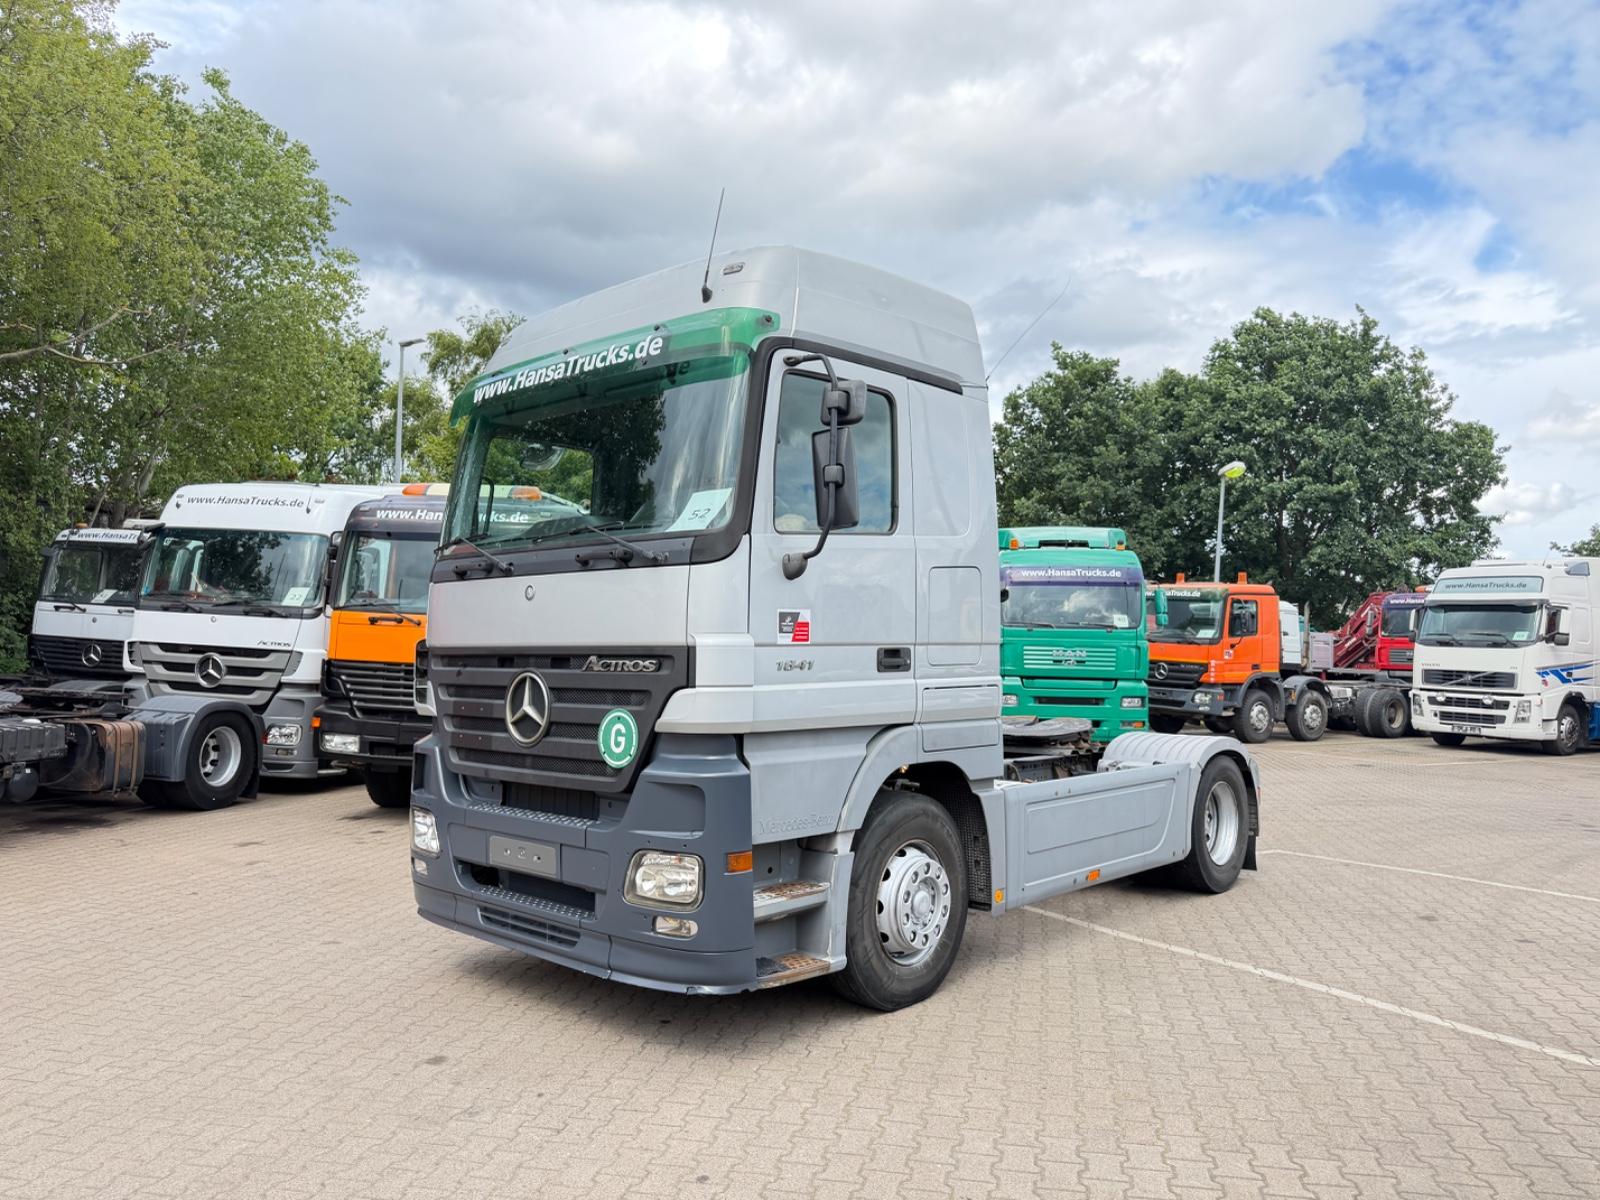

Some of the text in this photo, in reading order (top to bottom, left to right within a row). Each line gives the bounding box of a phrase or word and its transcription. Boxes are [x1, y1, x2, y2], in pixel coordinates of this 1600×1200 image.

[474, 335, 662, 404] www.HansaTrucks.de
[187, 496, 304, 507] www.HansaTrucks.de
[688, 508, 711, 520] 52
[78, 532, 137, 540] www.HansaTr
[1021, 569, 1122, 577] www.HansaTrucks.de
[610, 723, 626, 753] G
